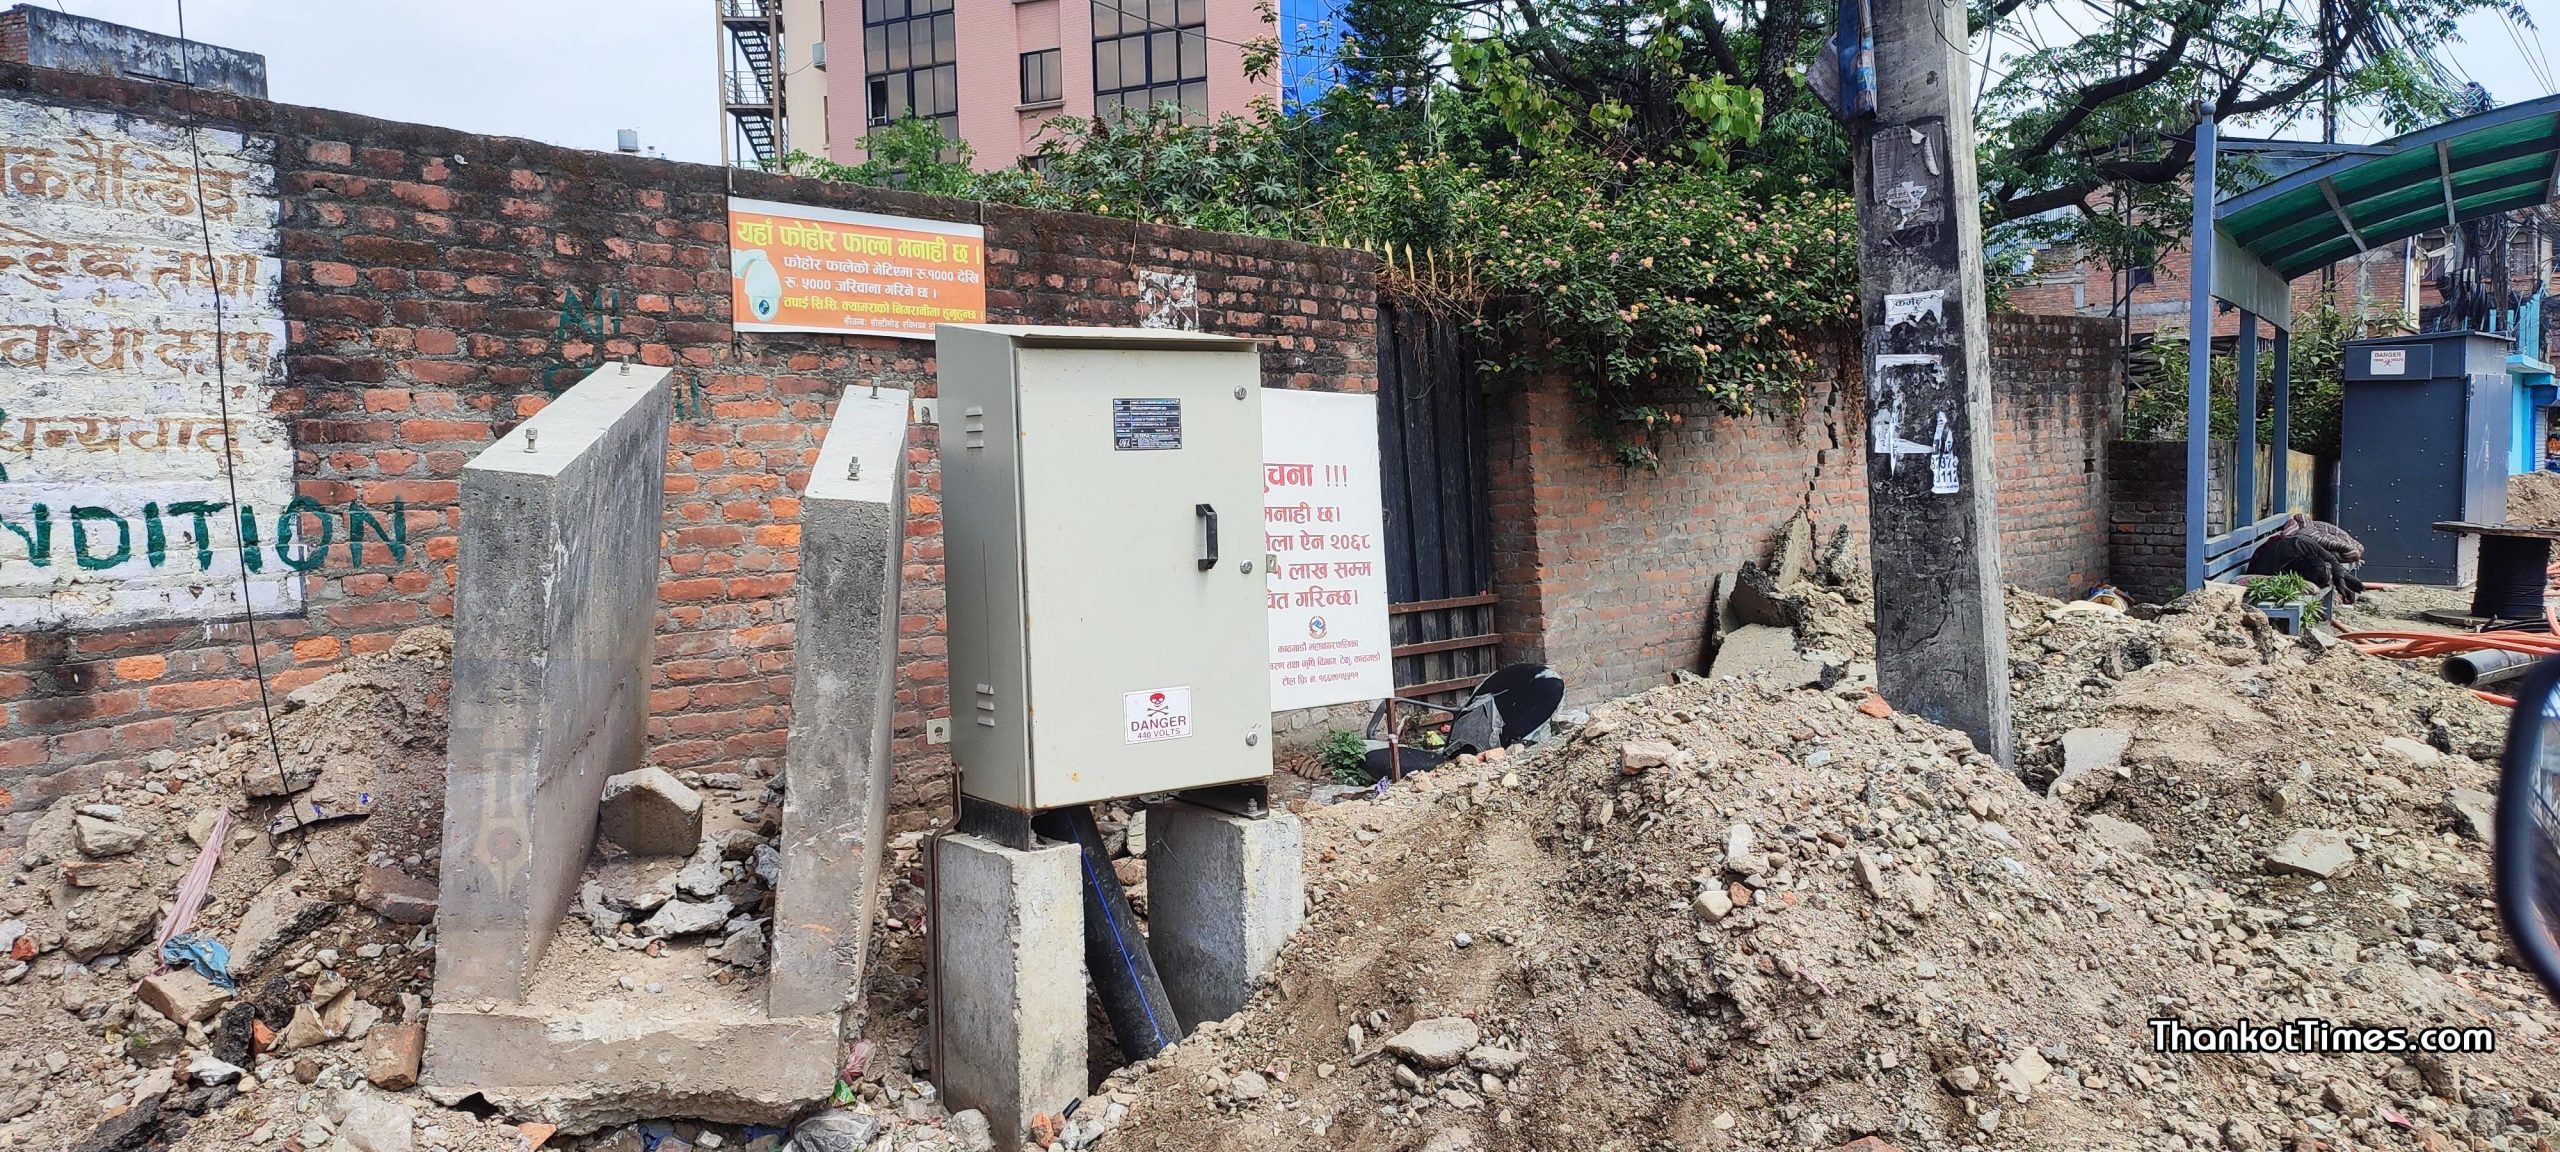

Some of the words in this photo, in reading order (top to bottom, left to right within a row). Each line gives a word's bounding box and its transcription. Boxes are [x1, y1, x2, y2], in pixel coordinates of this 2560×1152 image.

[736, 217, 774, 247] यहाँ
[779, 220, 837, 253] फोहोर
[841, 232, 893, 257] फाल्न
[897, 236, 948, 263] मनाही
[952, 243, 970, 265] छ
[783, 254, 823, 271] फोहोर
[826, 258, 869, 274] फालेको
[957, 268, 980, 284] देखि
[801, 278, 831, 290] ५०००
[835, 278, 881, 295] जरिवाना
[884, 282, 914, 297] गरिने
[916, 287, 929, 299] छ
[1263, 463, 1314, 493] चना
[1299, 530, 1325, 551] ऐन
[1331, 534, 1371, 551] २०६८
[1288, 562, 1328, 580] लाख
[1334, 561, 1372, 579] सम्म
[1131, 715, 1187, 732] DANGER
[1137, 731, 1152, 739] 440
[1153, 727, 1181, 738] VOLTS
